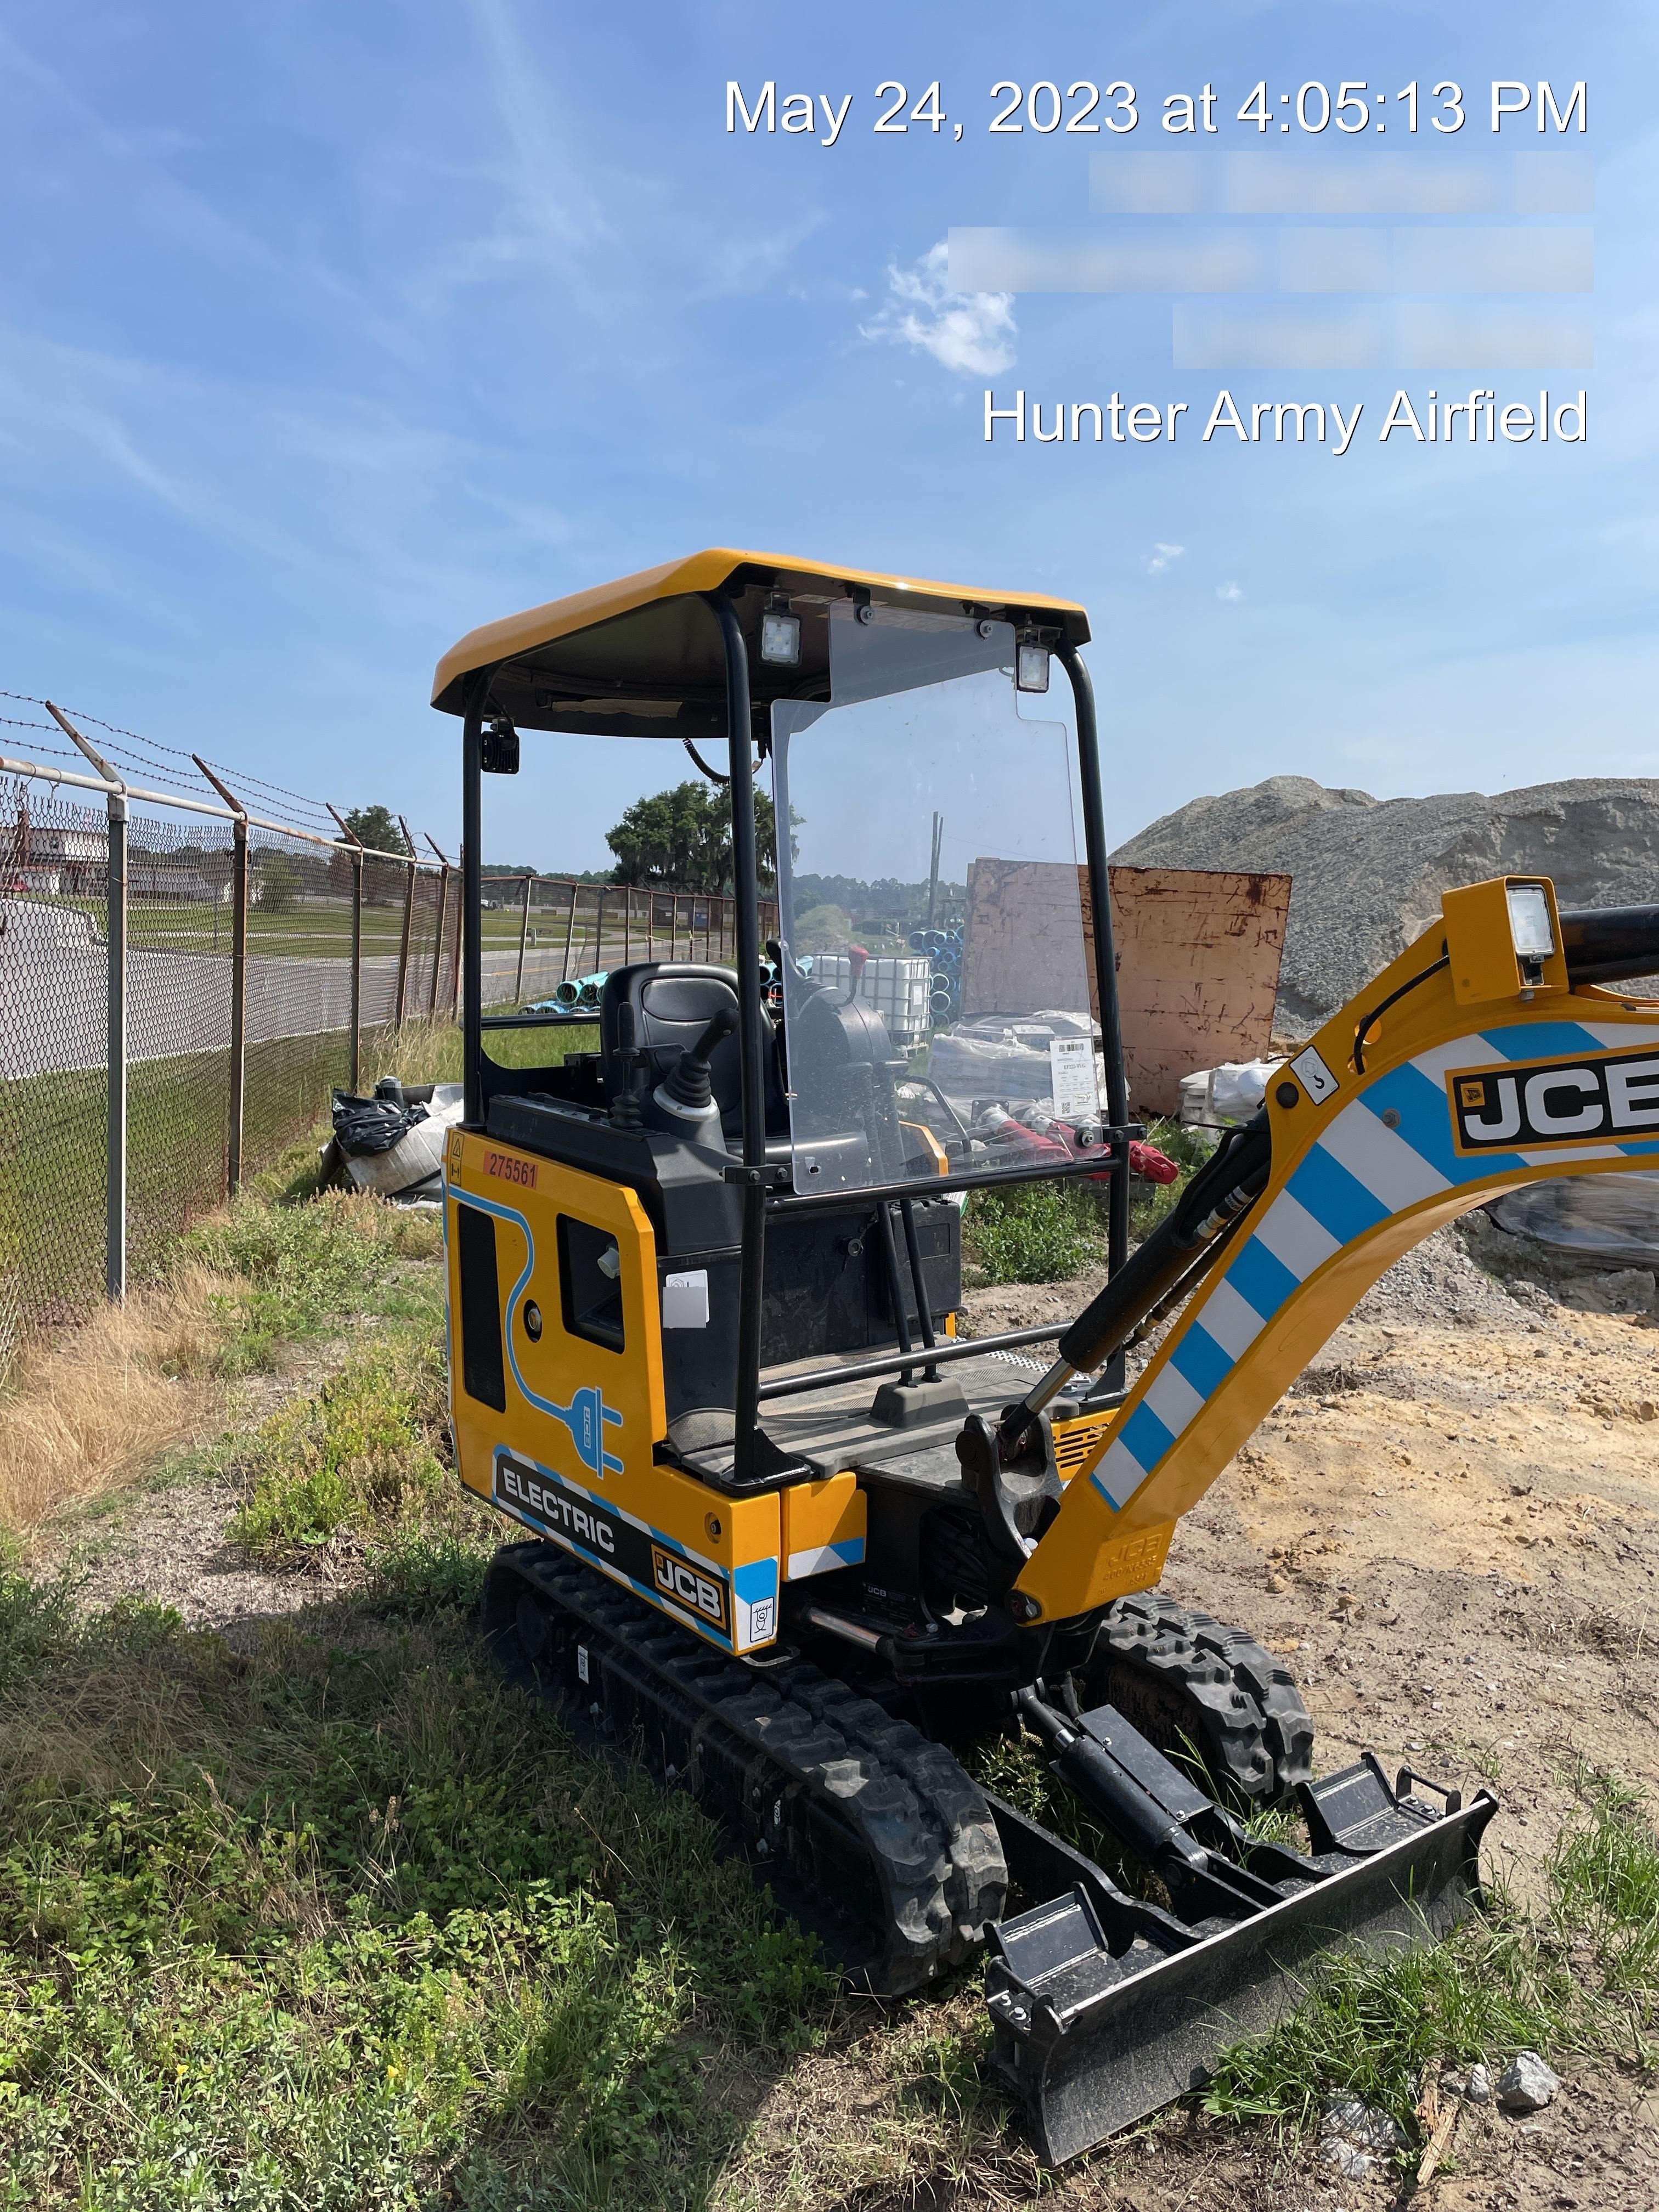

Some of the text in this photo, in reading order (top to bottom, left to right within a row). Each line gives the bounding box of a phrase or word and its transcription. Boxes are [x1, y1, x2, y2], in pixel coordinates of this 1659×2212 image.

[489, 1153, 537, 1188] 275561
[503, 1467, 615, 1553] ELECTRIC
[657, 1560, 721, 1618] JCB
[867, 1584, 887, 1598] JCB
